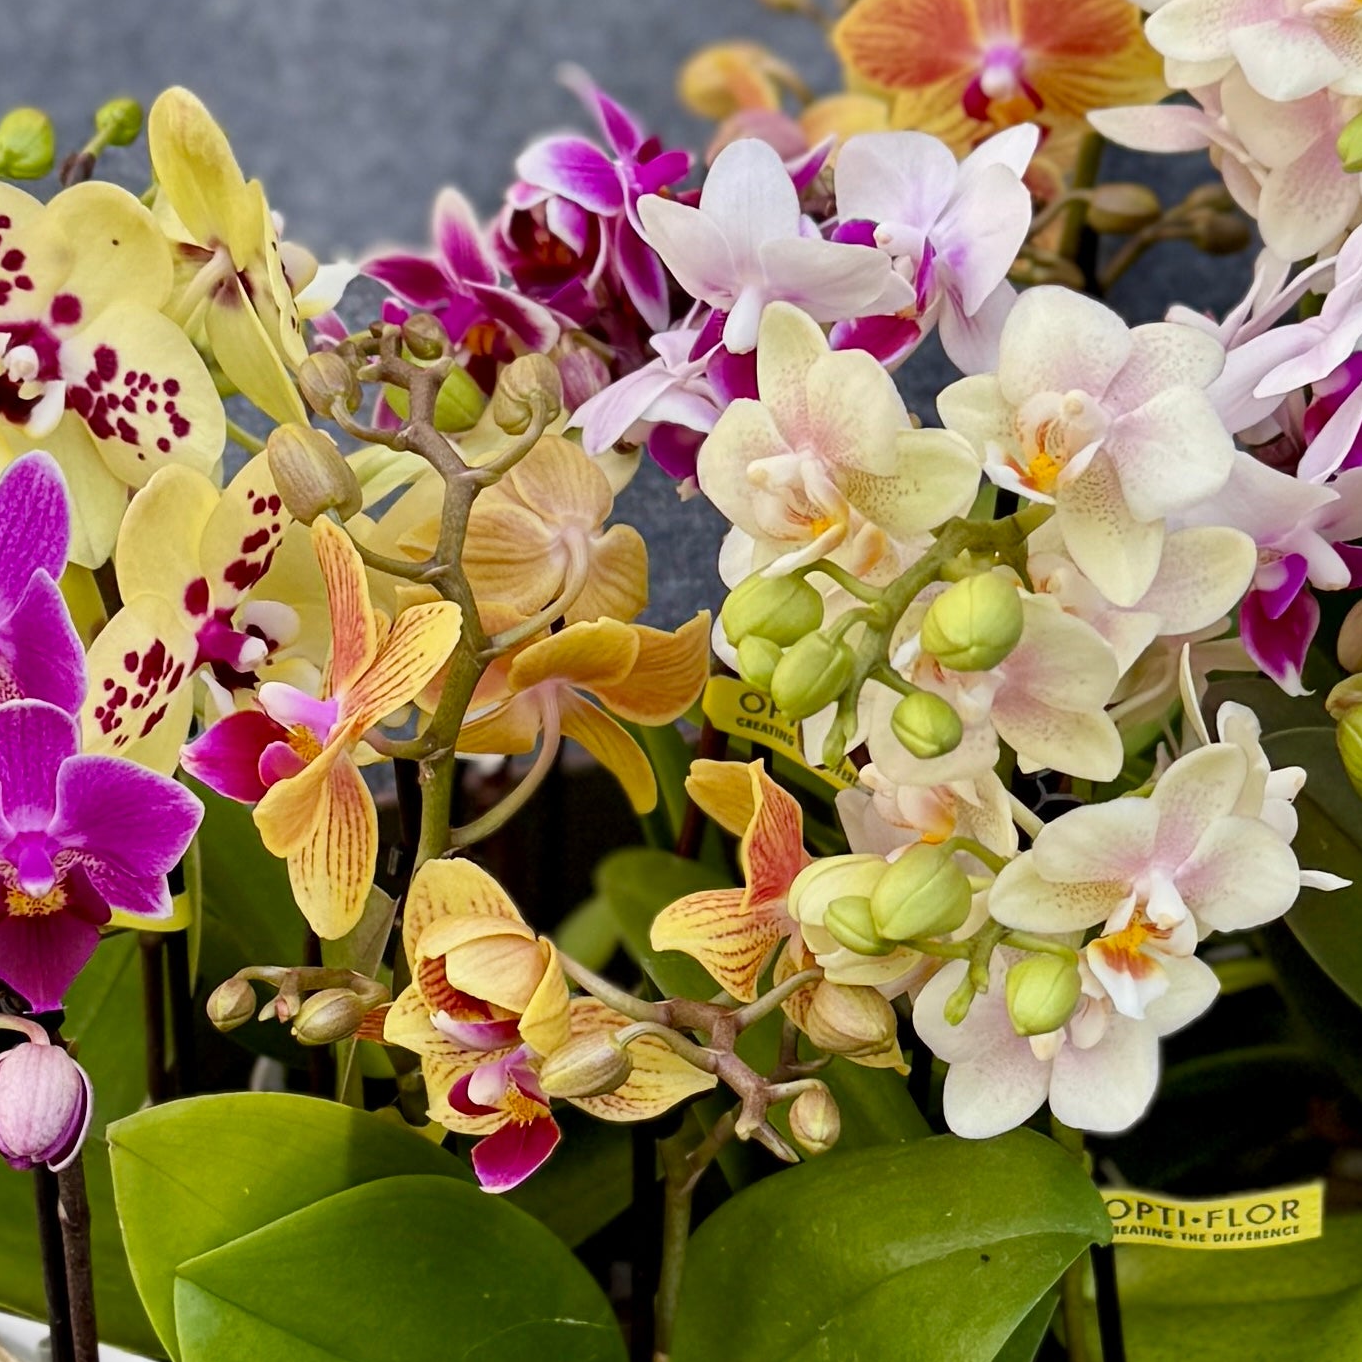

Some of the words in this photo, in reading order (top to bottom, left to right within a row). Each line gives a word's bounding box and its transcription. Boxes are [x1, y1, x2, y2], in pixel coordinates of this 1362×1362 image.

[736, 717, 795, 747] CREATING
[1181, 1232, 1206, 1243] THE
[1213, 1225, 1300, 1243] DIFFERENCE
